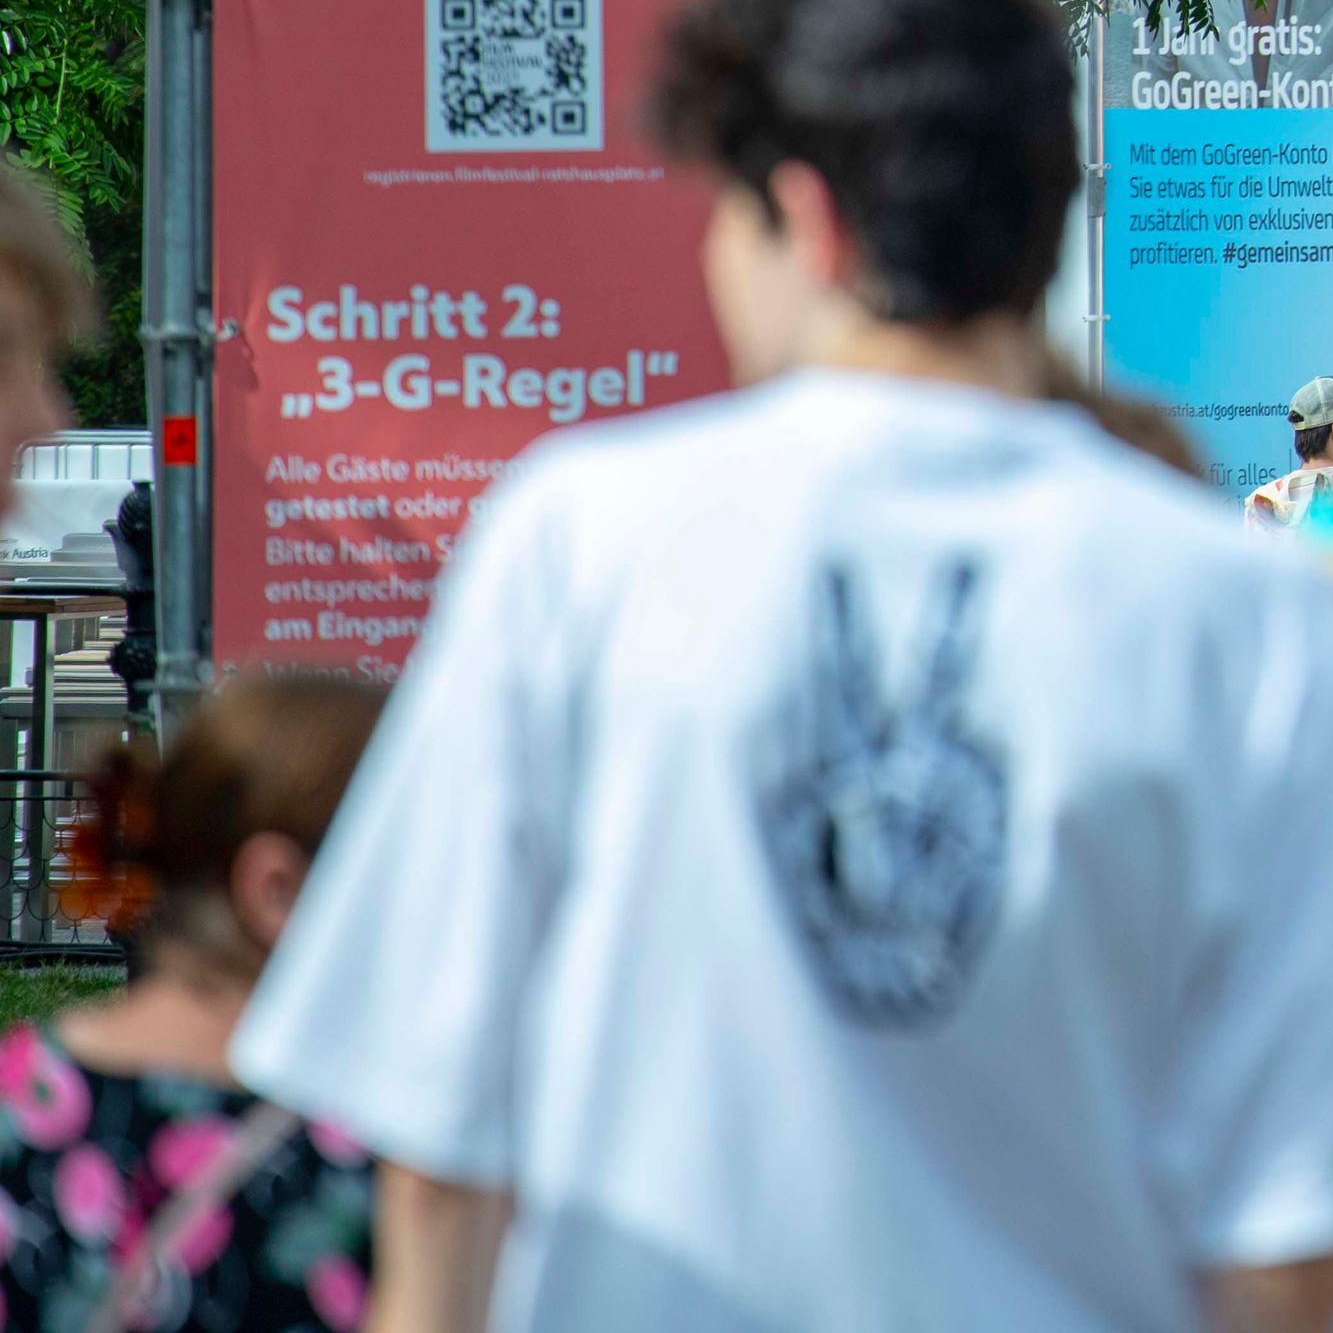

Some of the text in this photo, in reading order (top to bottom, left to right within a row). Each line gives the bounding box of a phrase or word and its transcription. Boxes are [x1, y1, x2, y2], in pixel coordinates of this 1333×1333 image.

[1132, 15, 1322, 66] 1 gratis:
[1130, 143, 1156, 165] Mit
[1160, 142, 1197, 165] dem
[1202, 143, 1328, 165] GoGreen-Konto
[1130, 176, 1152, 198] Sie
[1158, 179, 1205, 198] etwas
[1210, 175, 1234, 198] für
[1238, 176, 1263, 198] die
[1268, 175, 1333, 198] Umwelt
[1130, 209, 1208, 231] zusätzlich
[1214, 215, 1243, 231] von
[1249, 208, 1333, 231] exklusiven
[1130, 243, 1218, 270] profitieren.
[265, 283, 560, 341] Schritt 2:
[264, 453, 411, 484] Alle Gäste
[264, 495, 390, 529] getestet
[394, 490, 462, 519] oder
[264, 536, 335, 565] Bitte
[339, 535, 431, 564] halten
[264, 618, 312, 642] am
